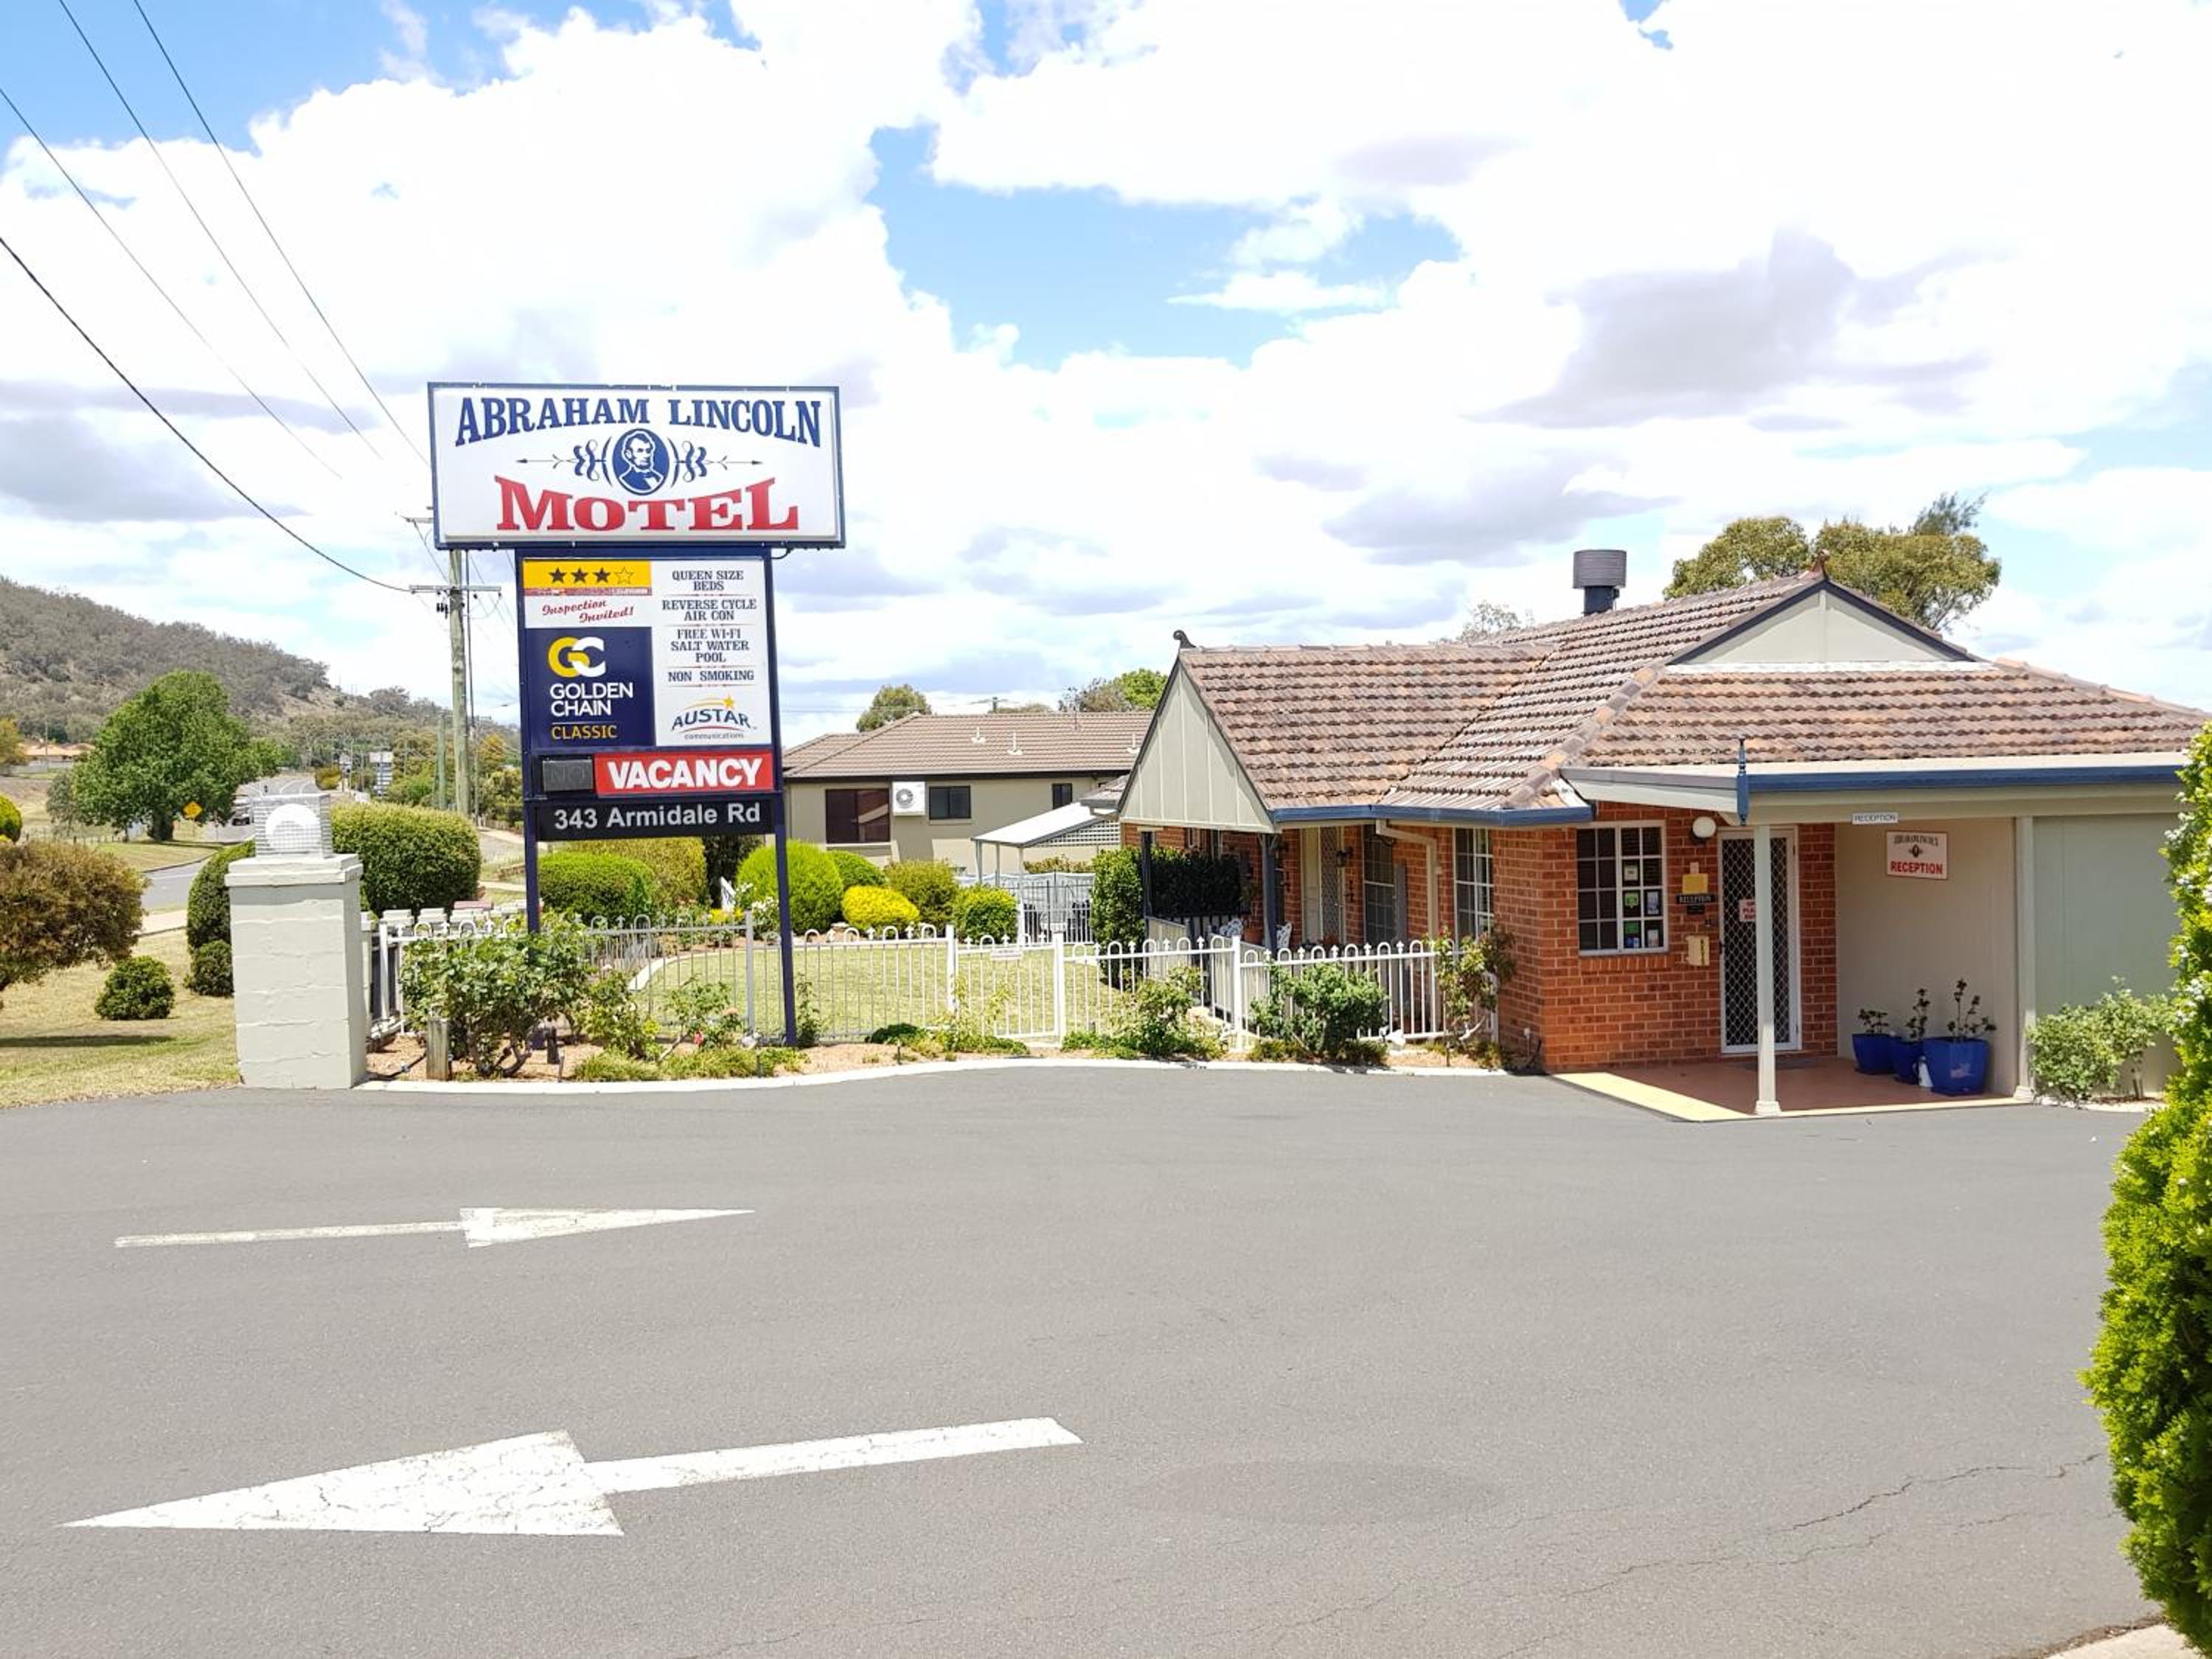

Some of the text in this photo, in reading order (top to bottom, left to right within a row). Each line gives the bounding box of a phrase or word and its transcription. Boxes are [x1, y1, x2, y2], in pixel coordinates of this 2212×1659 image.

[456, 397, 821, 448] ABRAHAM LINCOLN
[494, 474, 799, 532] MOTEL
[672, 570, 744, 581] QUEEN SIZE
[693, 581, 724, 591] BEDS
[542, 599, 607, 616] Inspection
[662, 599, 757, 611] REVERSE CYCLE
[684, 610, 734, 622] AIR CON
[677, 628, 707, 639] FREE
[670, 640, 750, 651] SALT WATER
[695, 652, 726, 663] POOL
[667, 670, 754, 682] NON SMOKING
[549, 682, 634, 700] GOLDEN
[551, 700, 612, 717] CHAIN
[671, 709, 751, 731] AUSTAR
[552, 725, 618, 740] CLASSIC
[607, 757, 763, 790] VACANCY
[554, 801, 760, 830] 343 Armidale Rd
[1890, 860, 1943, 874] RECEPTION
